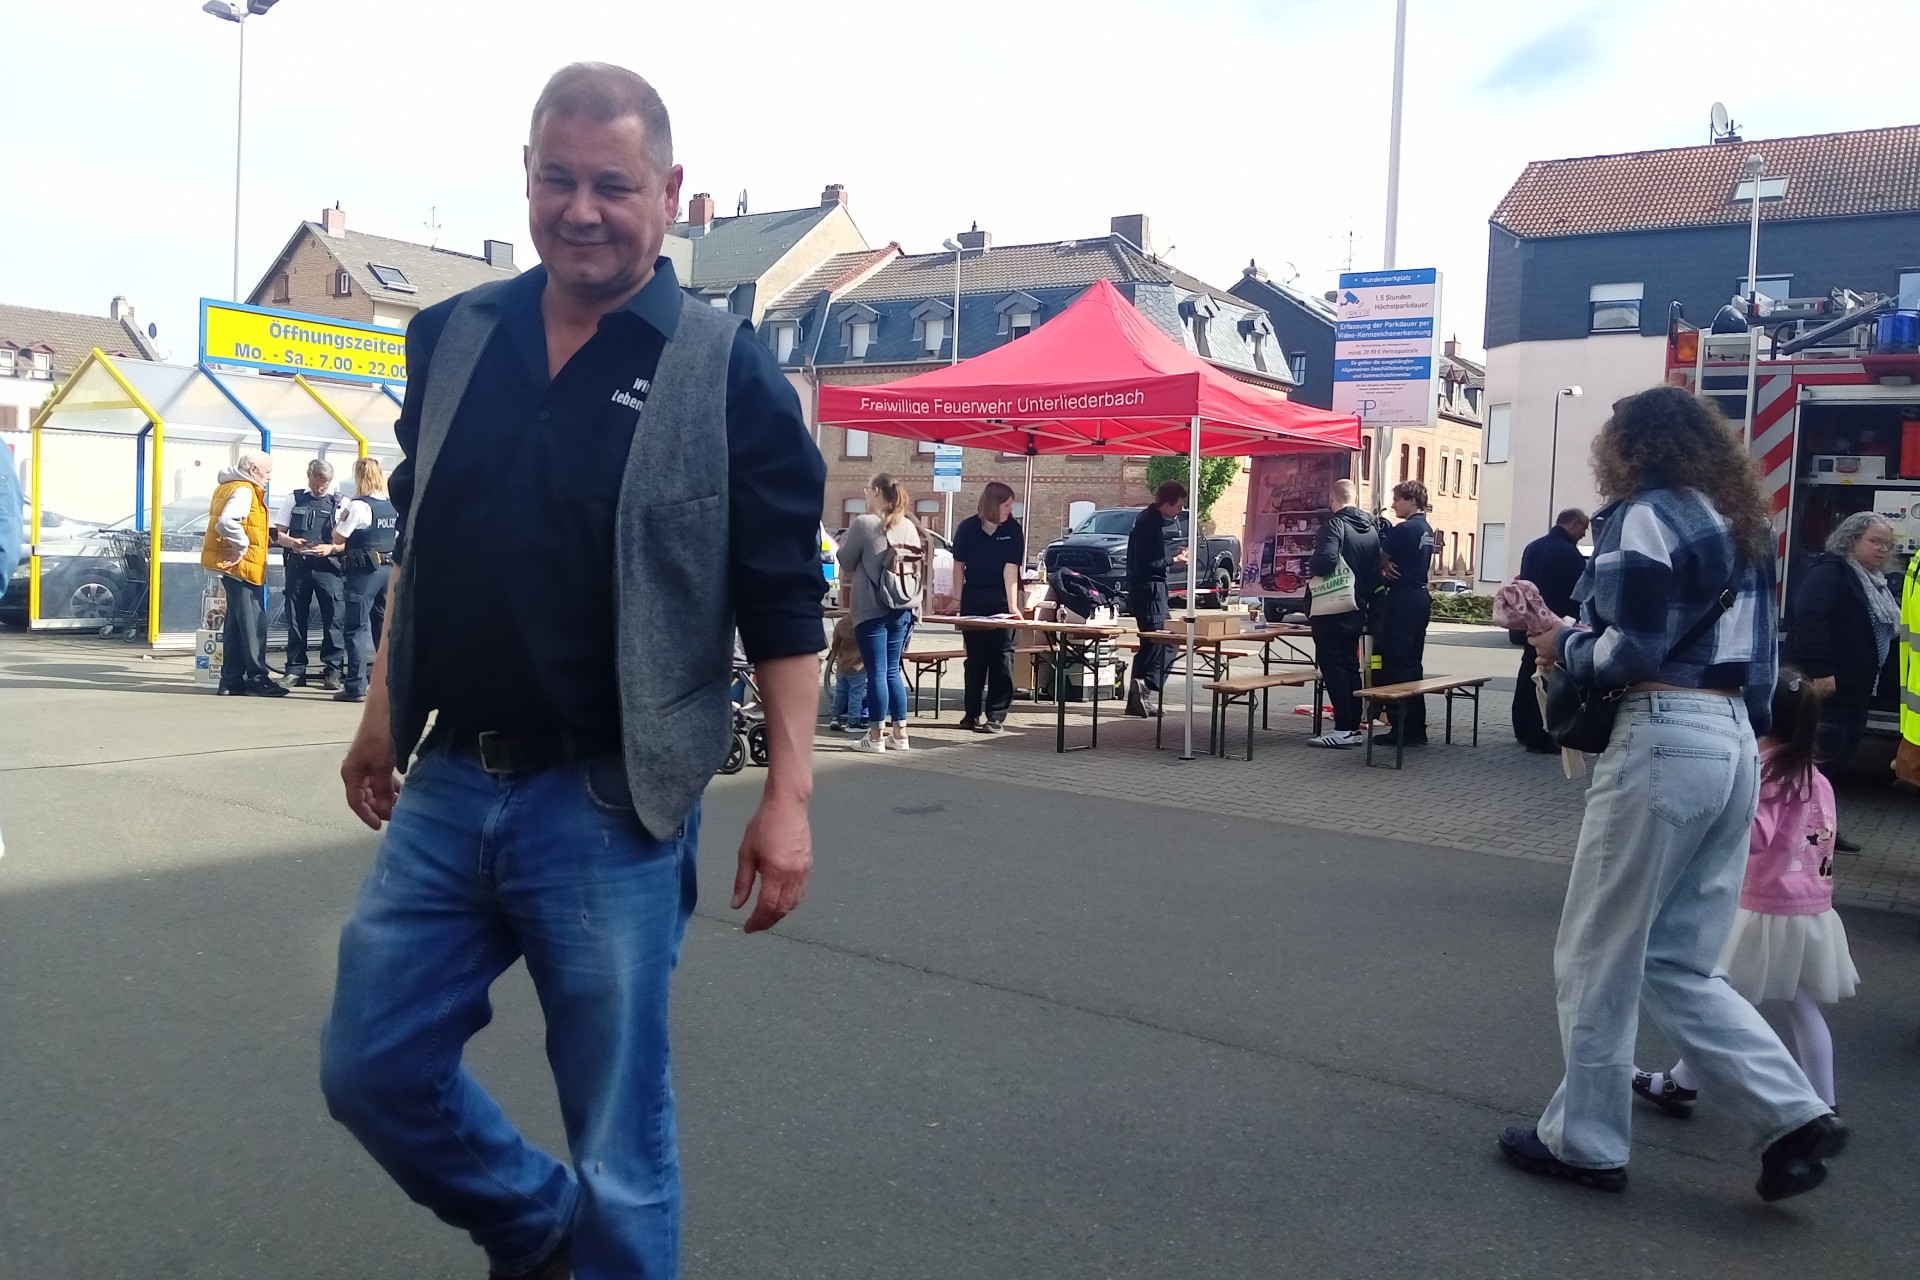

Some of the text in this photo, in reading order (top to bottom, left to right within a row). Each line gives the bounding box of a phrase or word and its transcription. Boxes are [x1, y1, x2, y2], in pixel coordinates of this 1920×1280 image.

[1362, 274, 1411, 283] Kundenparkplatz
[1374, 302, 1428, 310] Höchstparkdauer
[1340, 323, 1371, 331] Erfassung
[1384, 320, 1417, 328] Parkdauer
[1419, 320, 1430, 328] per
[269, 319, 406, 356] Öffnungszeiten
[235, 342, 267, 361] Mo.
[284, 350, 314, 367] Sa.:
[319, 354, 353, 372] 7.00
[368, 361, 407, 378] 22.00
[611, 389, 644, 411] Leben
[859, 388, 1145, 415] Freiwillige Feuerwehr Unterliederbach
